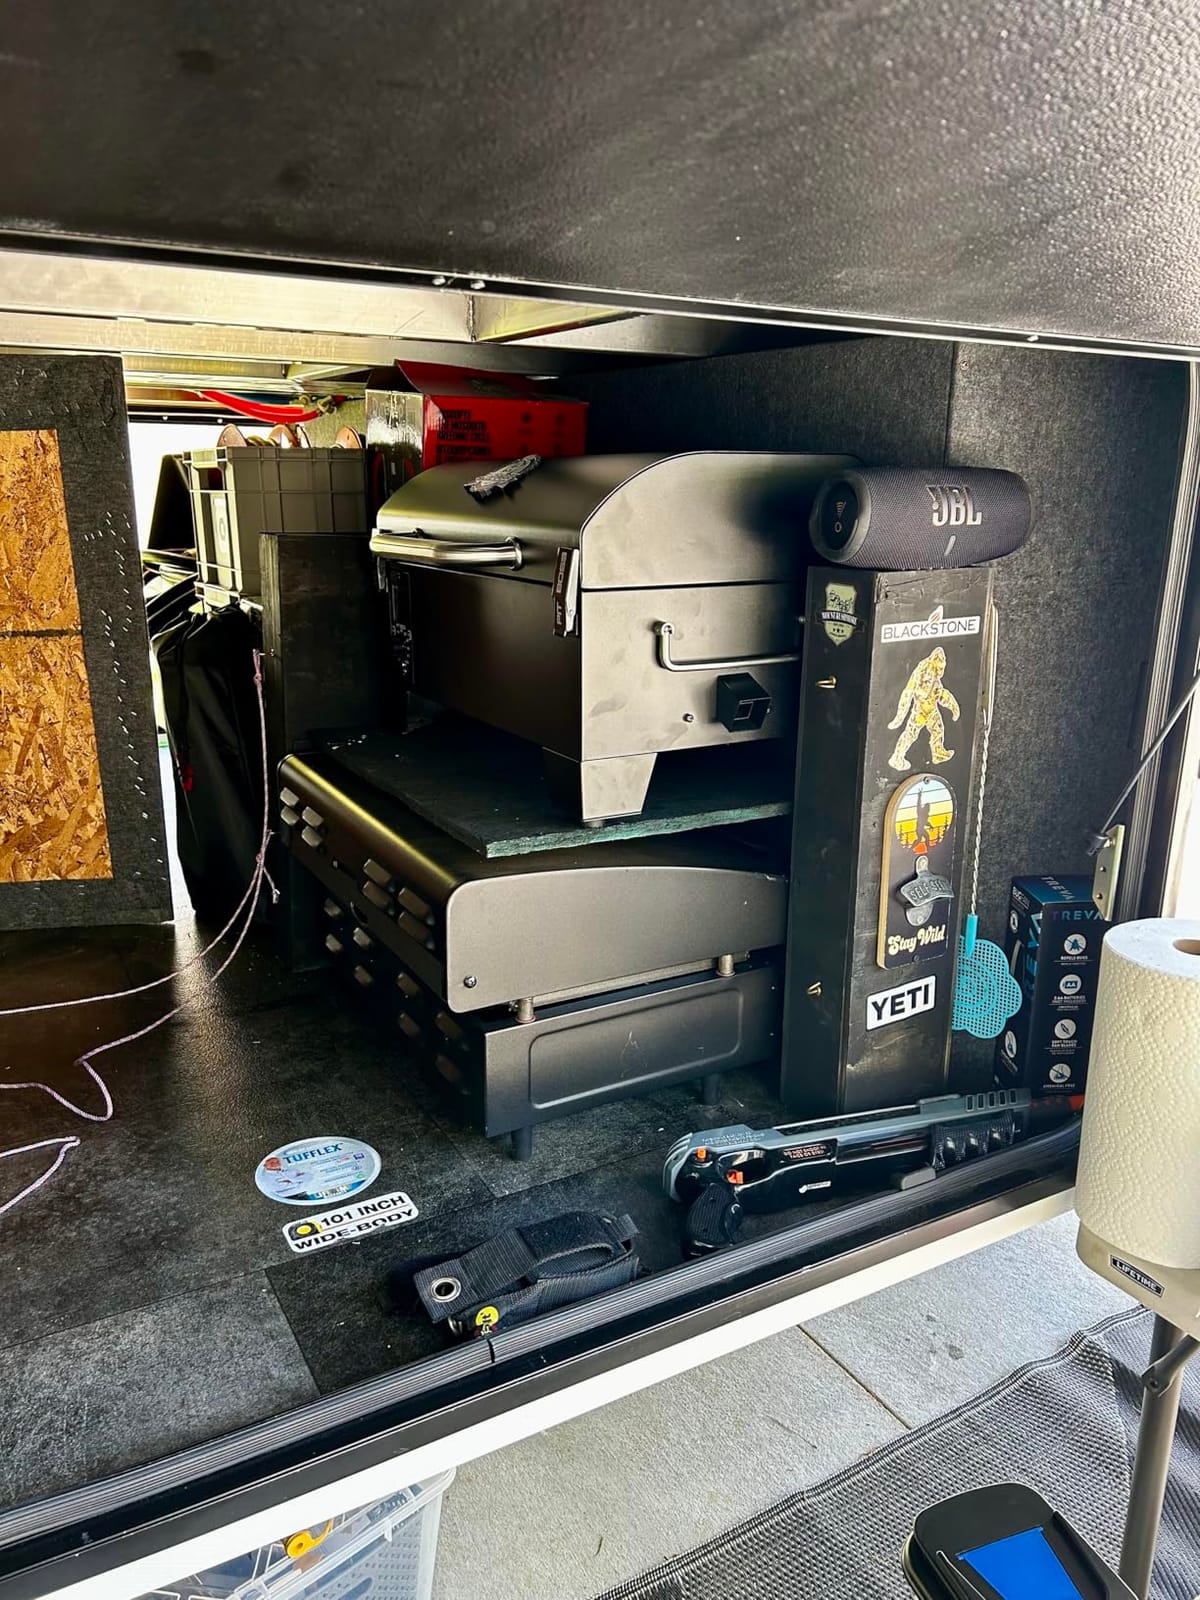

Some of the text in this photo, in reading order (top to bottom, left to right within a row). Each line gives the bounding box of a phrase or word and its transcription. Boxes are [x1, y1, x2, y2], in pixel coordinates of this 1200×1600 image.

[926, 484, 982, 526] JBL
[556, 552, 567, 593] BOSS
[883, 619, 977, 639] BLACKSTONE
[910, 882, 931, 900] SELF
[1041, 876, 1075, 900] TREVA
[1052, 910, 1104, 921] TREVA
[888, 924, 945, 956] Stay Wild
[872, 983, 930, 1021] YETI
[283, 1143, 342, 1165] TUFFLEX
[321, 1196, 406, 1226] 101 INCH
[294, 1208, 414, 1250] WIDE-BODY
[1116, 1260, 1157, 1291] LIFETIME
